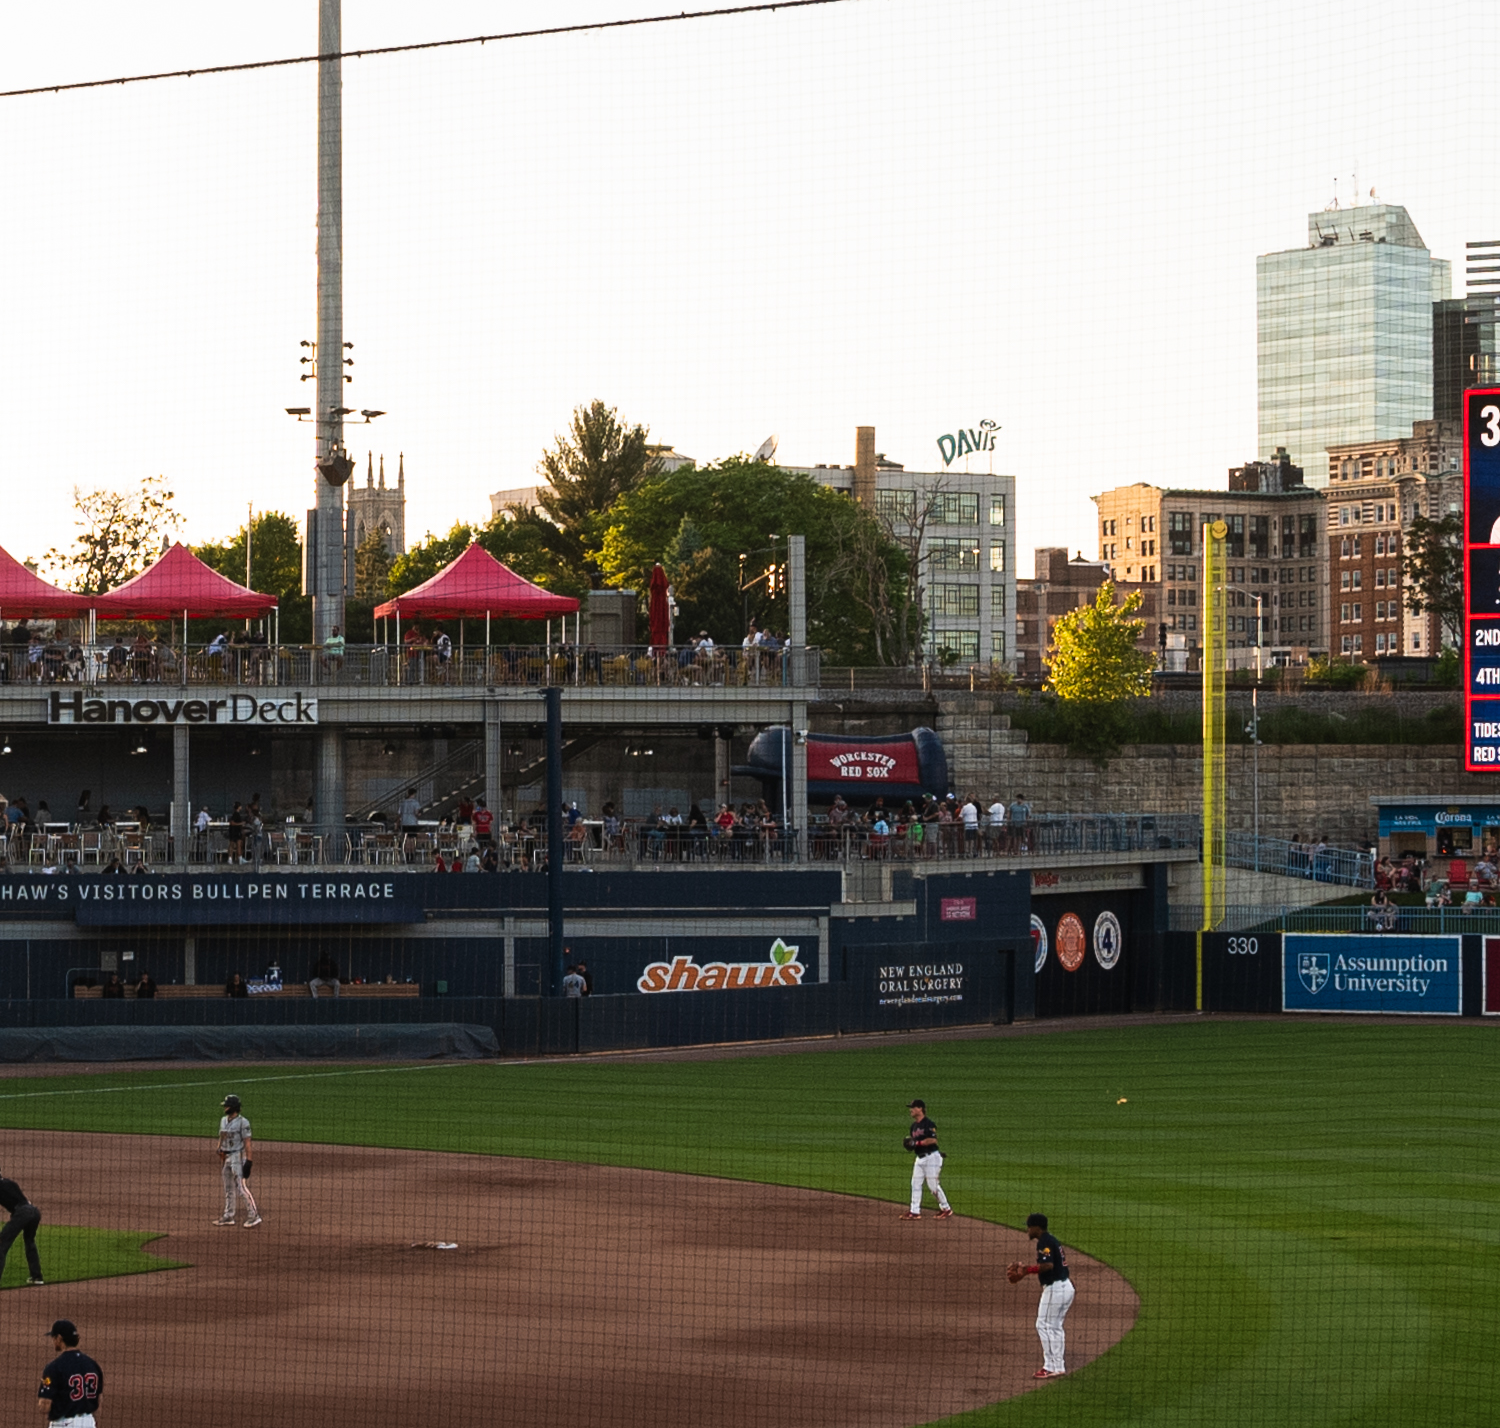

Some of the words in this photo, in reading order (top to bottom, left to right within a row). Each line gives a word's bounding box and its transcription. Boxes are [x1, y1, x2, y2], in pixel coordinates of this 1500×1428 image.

[51, 690, 227, 723] Hanover
[229, 692, 316, 723] Deck
[829, 751, 896, 769] WORCESTER
[1474, 747, 1496, 762] RED
[841, 766, 862, 777] RED
[866, 766, 889, 778] SOX
[1435, 811, 1472, 825] Corona
[78, 883, 183, 900] VISITORS
[193, 883, 288, 900] BULLPEN
[297, 882, 395, 899] TERRACE
[1227, 937, 1259, 955] 330
[879, 966, 905, 979] NEW
[909, 963, 964, 977] ENGLAND
[1334, 954, 1448, 977] Assumption
[879, 980, 910, 993] ORAL
[912, 977, 963, 991] SURGERY
[1334, 973, 1431, 996] University
